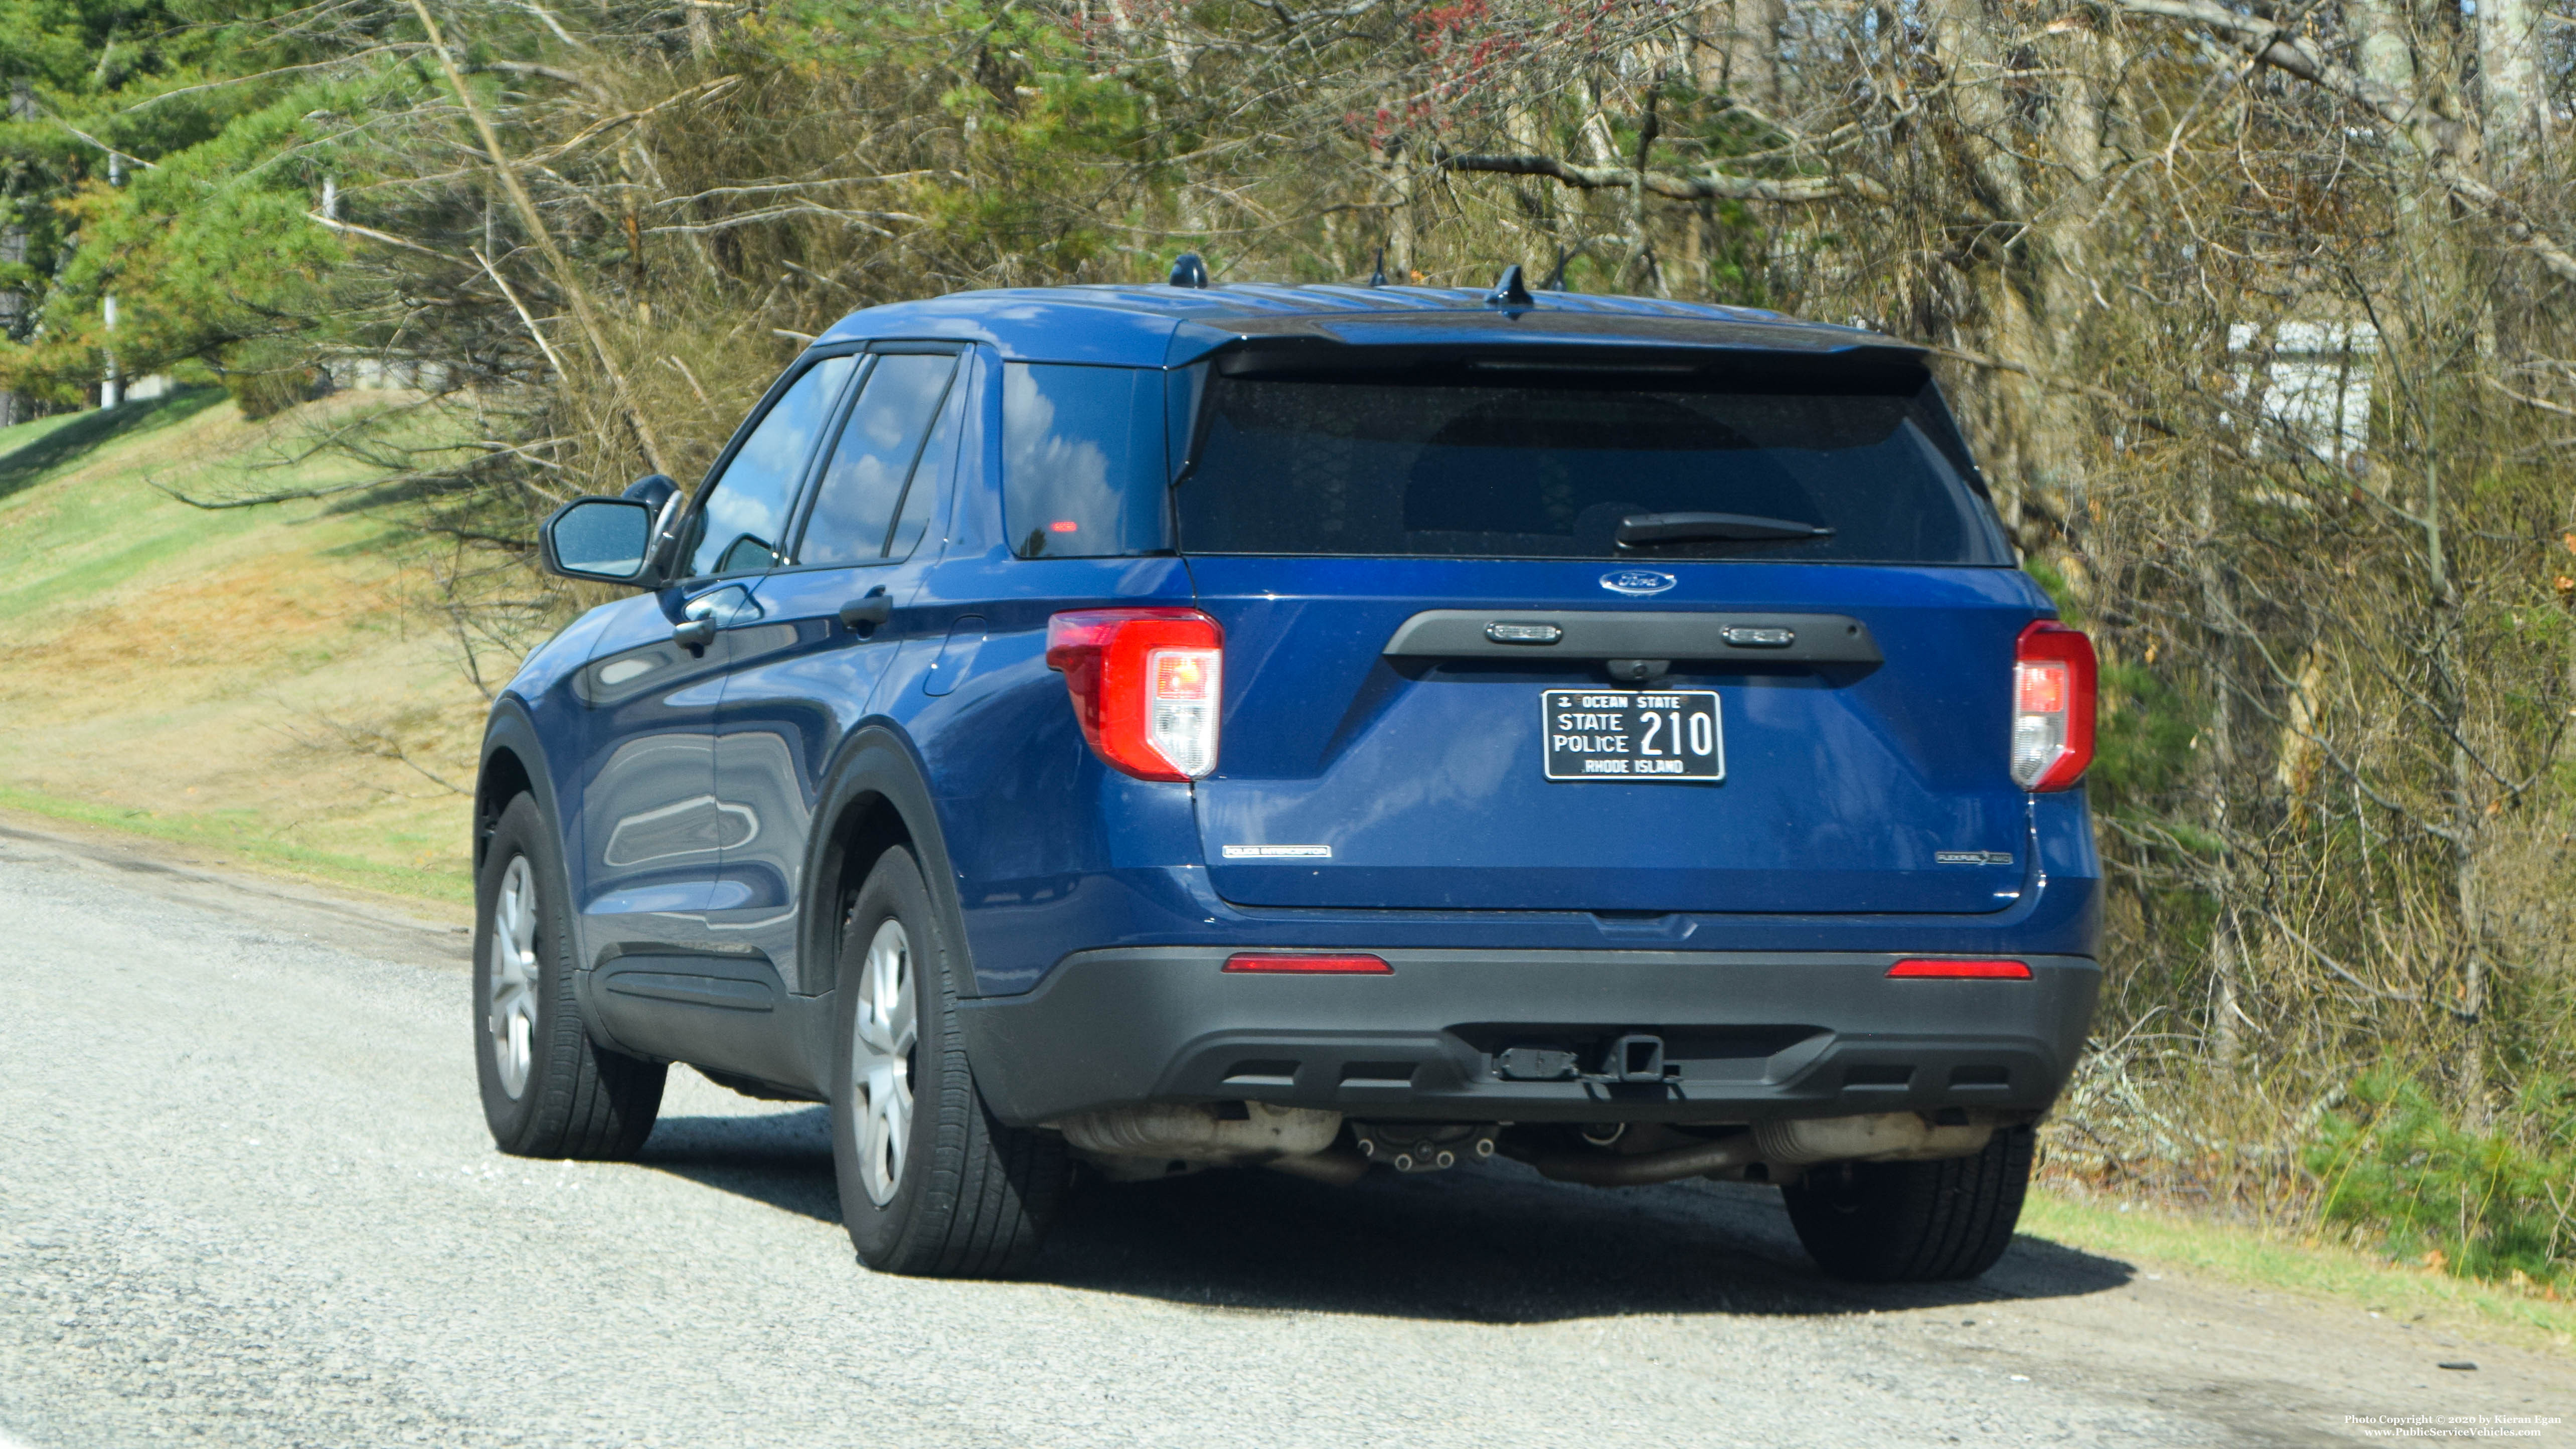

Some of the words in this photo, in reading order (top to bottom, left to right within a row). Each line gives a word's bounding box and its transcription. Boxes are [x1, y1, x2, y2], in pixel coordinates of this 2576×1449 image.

[1582, 696, 1629, 708] OCEAN
[1637, 696, 1681, 709] STATE
[1557, 713, 1624, 731] STATE
[1640, 711, 1713, 756] 210
[1553, 735, 1630, 753] POLICE
[1584, 759, 1630, 773] RHODE
[1634, 759, 1684, 774] ISLAND
